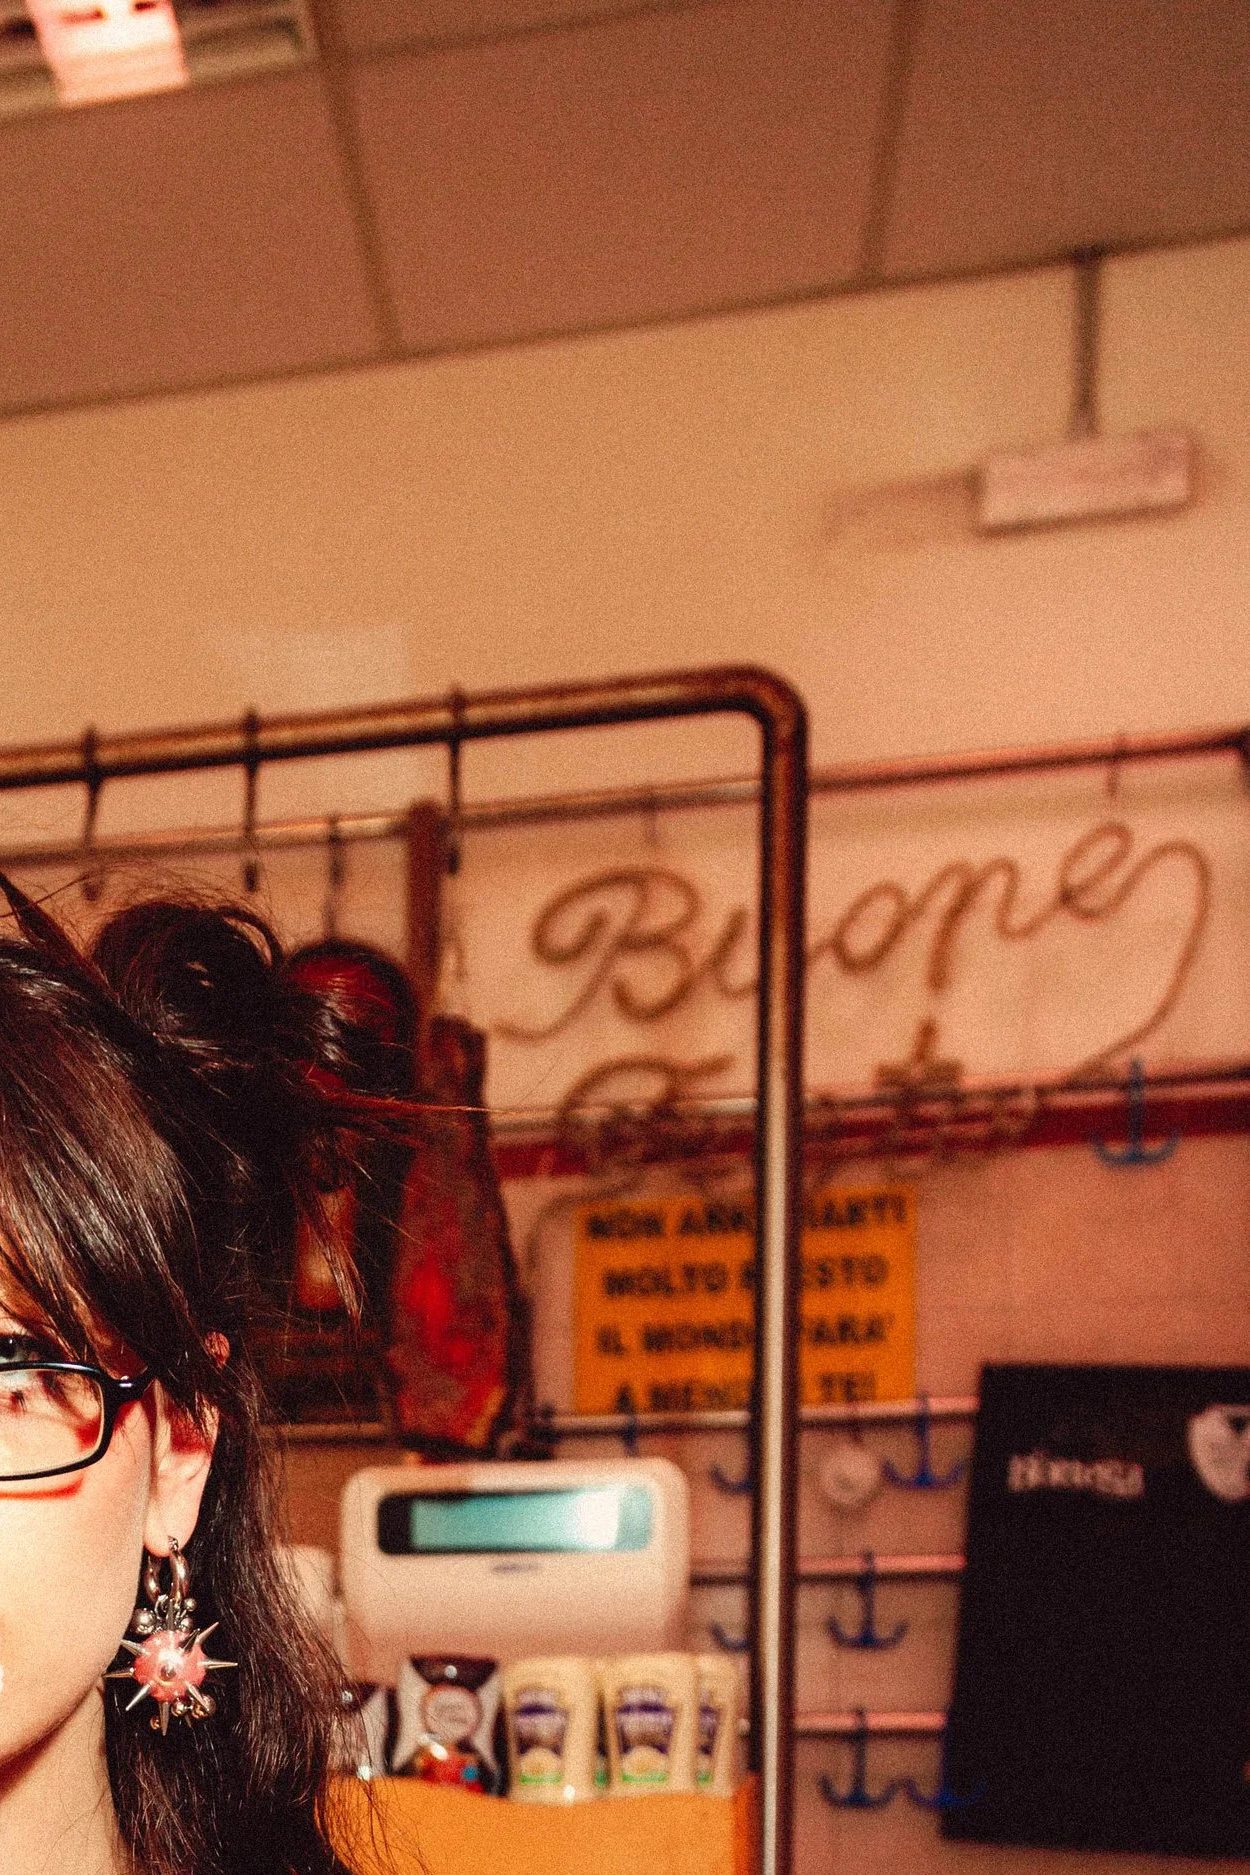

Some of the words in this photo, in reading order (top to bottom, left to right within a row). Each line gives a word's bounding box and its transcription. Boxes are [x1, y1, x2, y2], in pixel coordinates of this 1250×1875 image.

[587, 1208, 665, 1240] NON
[604, 1261, 729, 1298] MOLTO
[643, 1319, 754, 1353] MOND
